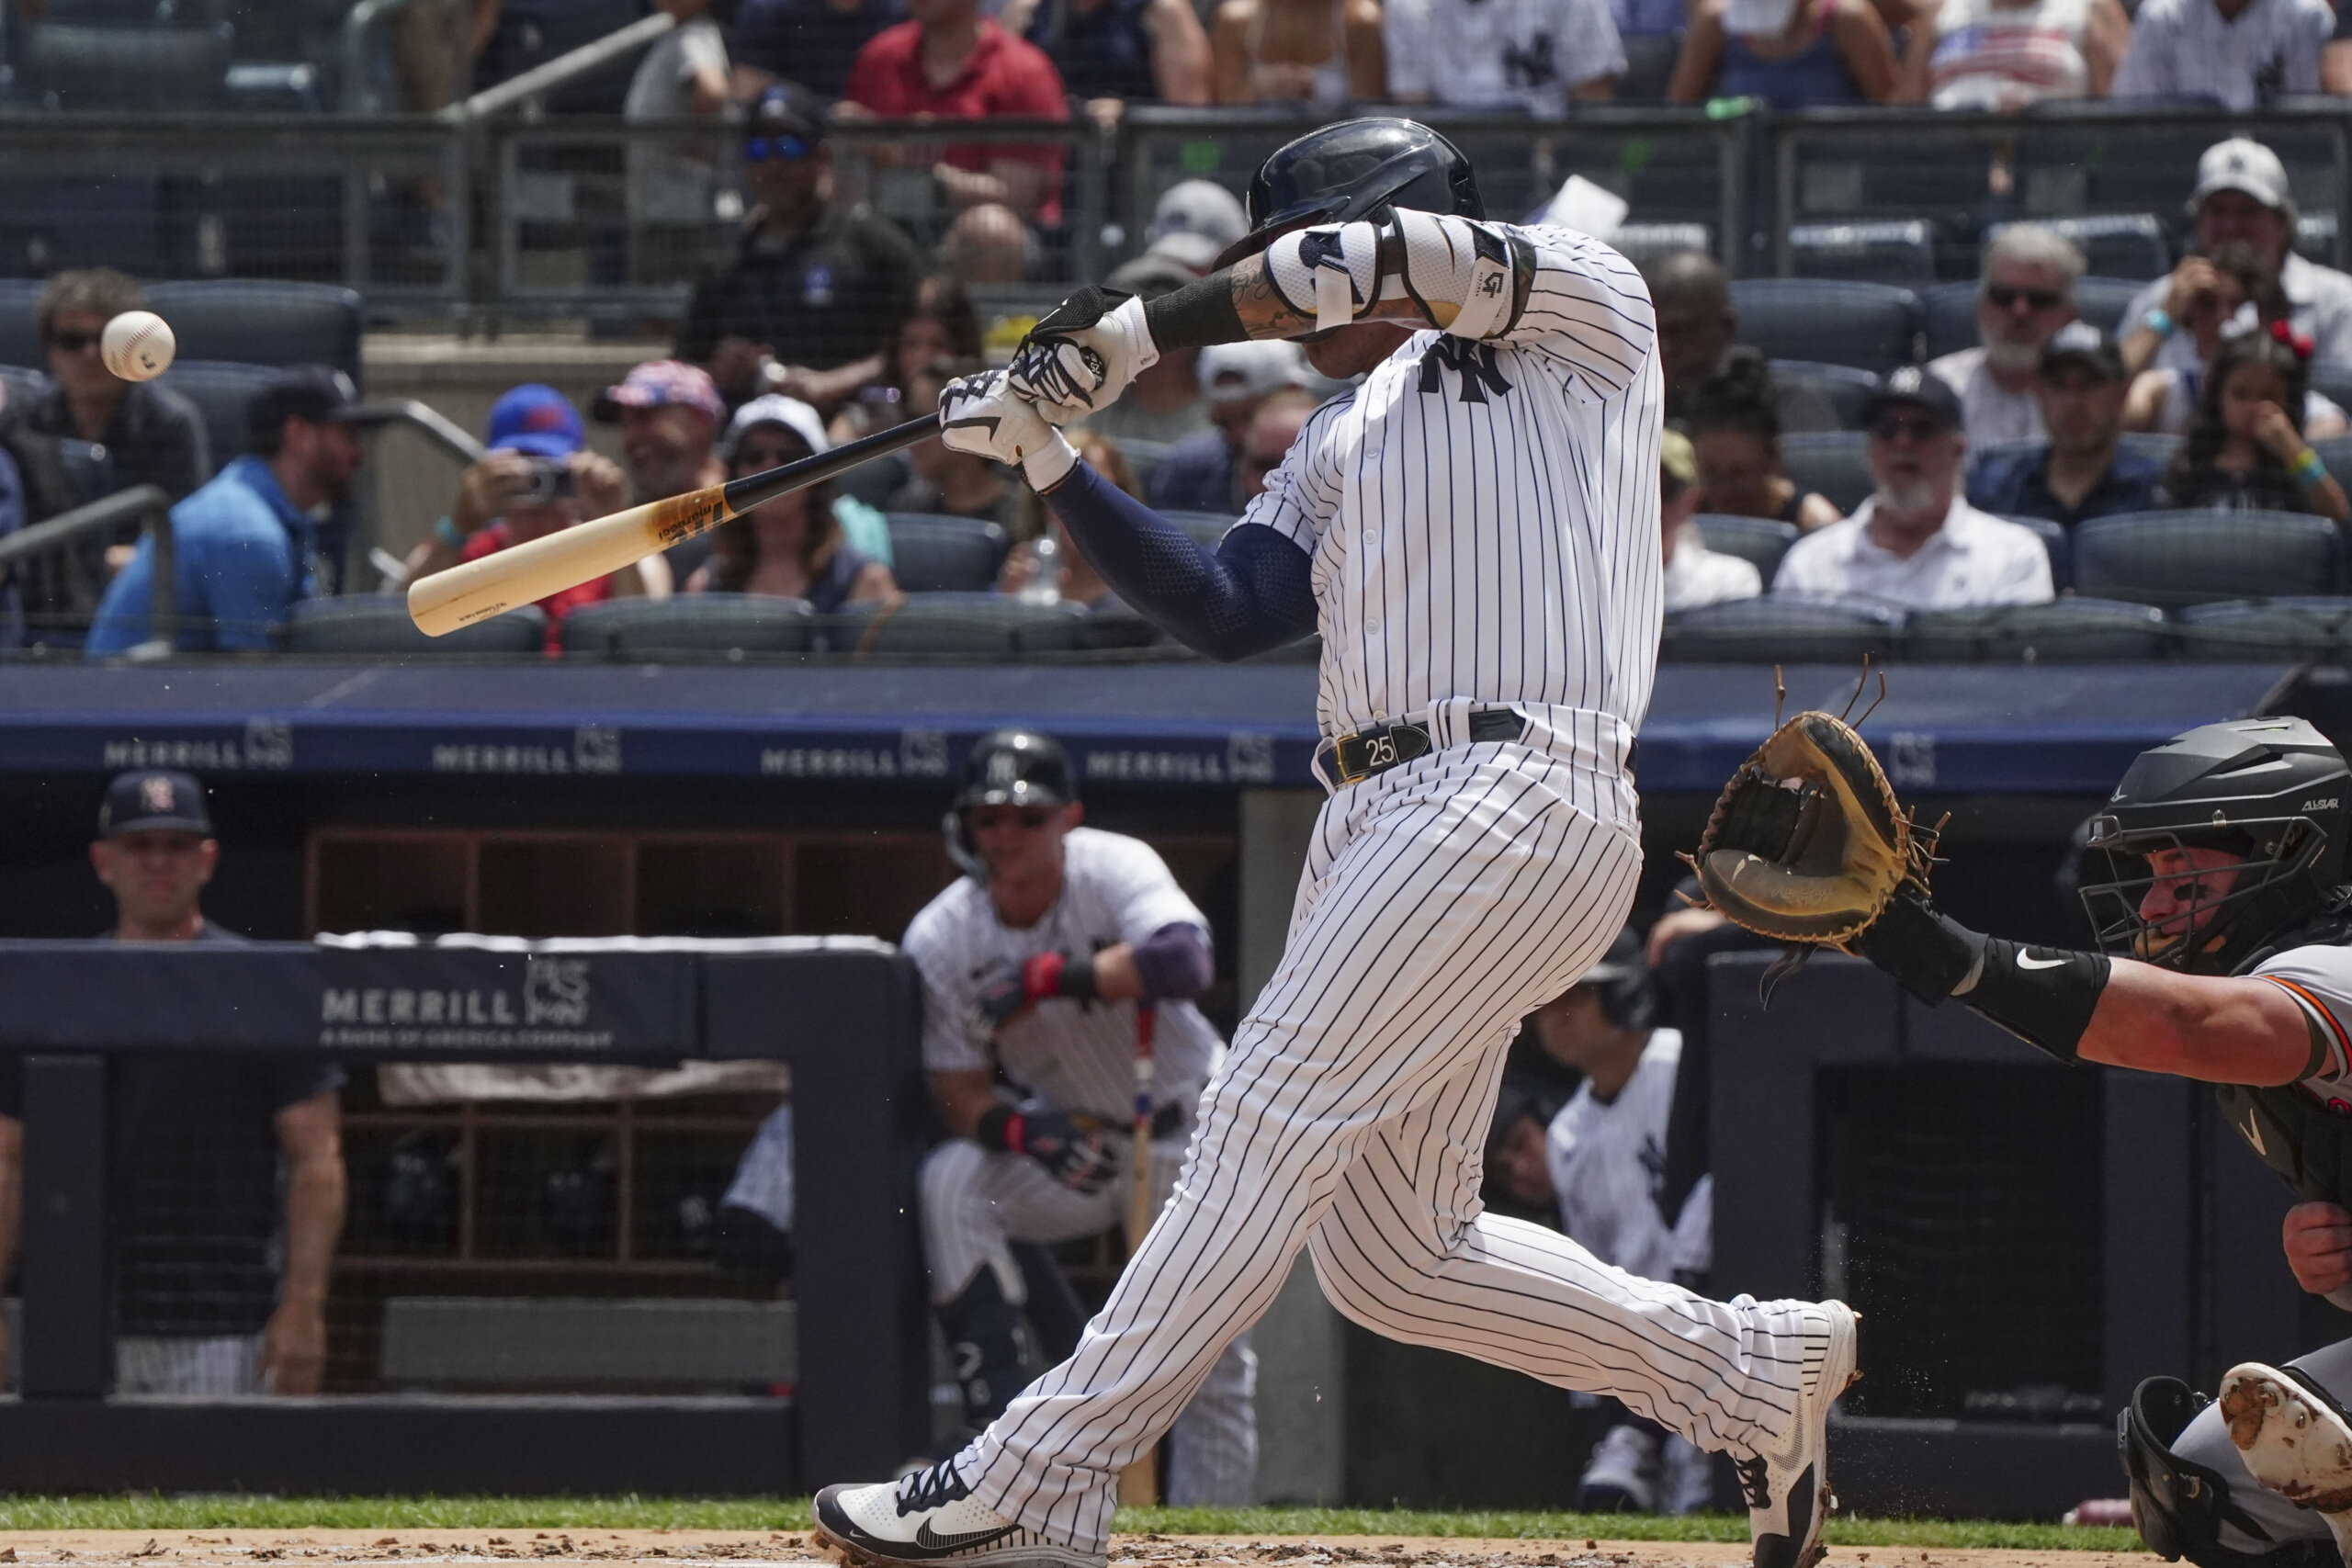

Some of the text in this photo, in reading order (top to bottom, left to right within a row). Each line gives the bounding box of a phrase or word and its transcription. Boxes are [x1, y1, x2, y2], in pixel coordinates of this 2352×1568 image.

[104, 740, 243, 770] MERRILL
[433, 744, 572, 774] MERRILL
[761, 748, 897, 777] MERRILL
[1087, 750, 1225, 783] MERRILL
[1365, 736, 1396, 767] 25
[322, 987, 519, 1025] MERRILL
